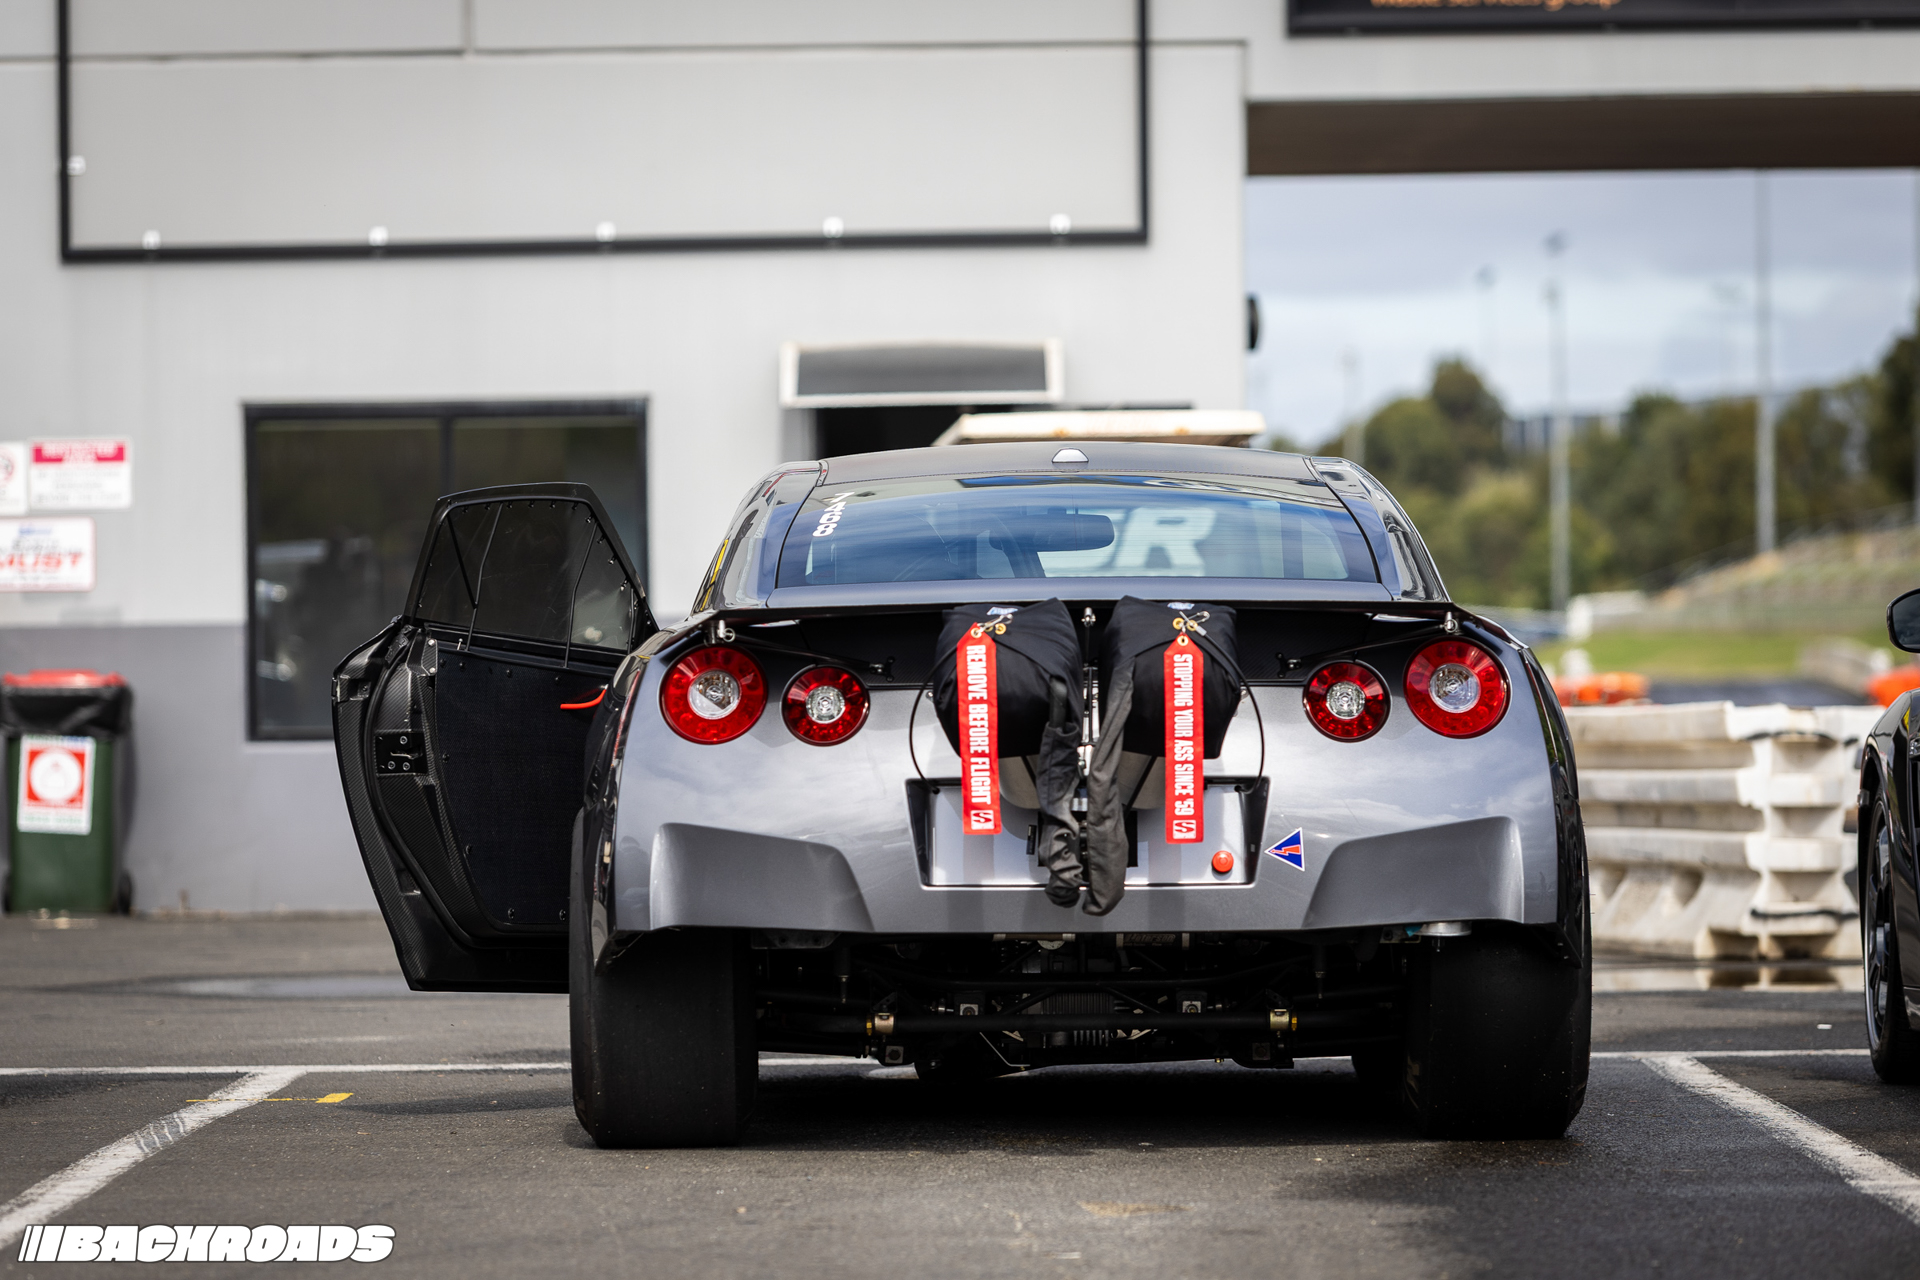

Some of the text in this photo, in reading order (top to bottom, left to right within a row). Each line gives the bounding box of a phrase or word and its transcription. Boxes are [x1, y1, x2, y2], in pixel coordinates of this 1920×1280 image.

[812, 491, 855, 537] 7468
[966, 644, 992, 805] REMOVE BEFORE FLIGHT
[1173, 653, 1195, 816] STOPPING YOUR ASS SINCE '59
